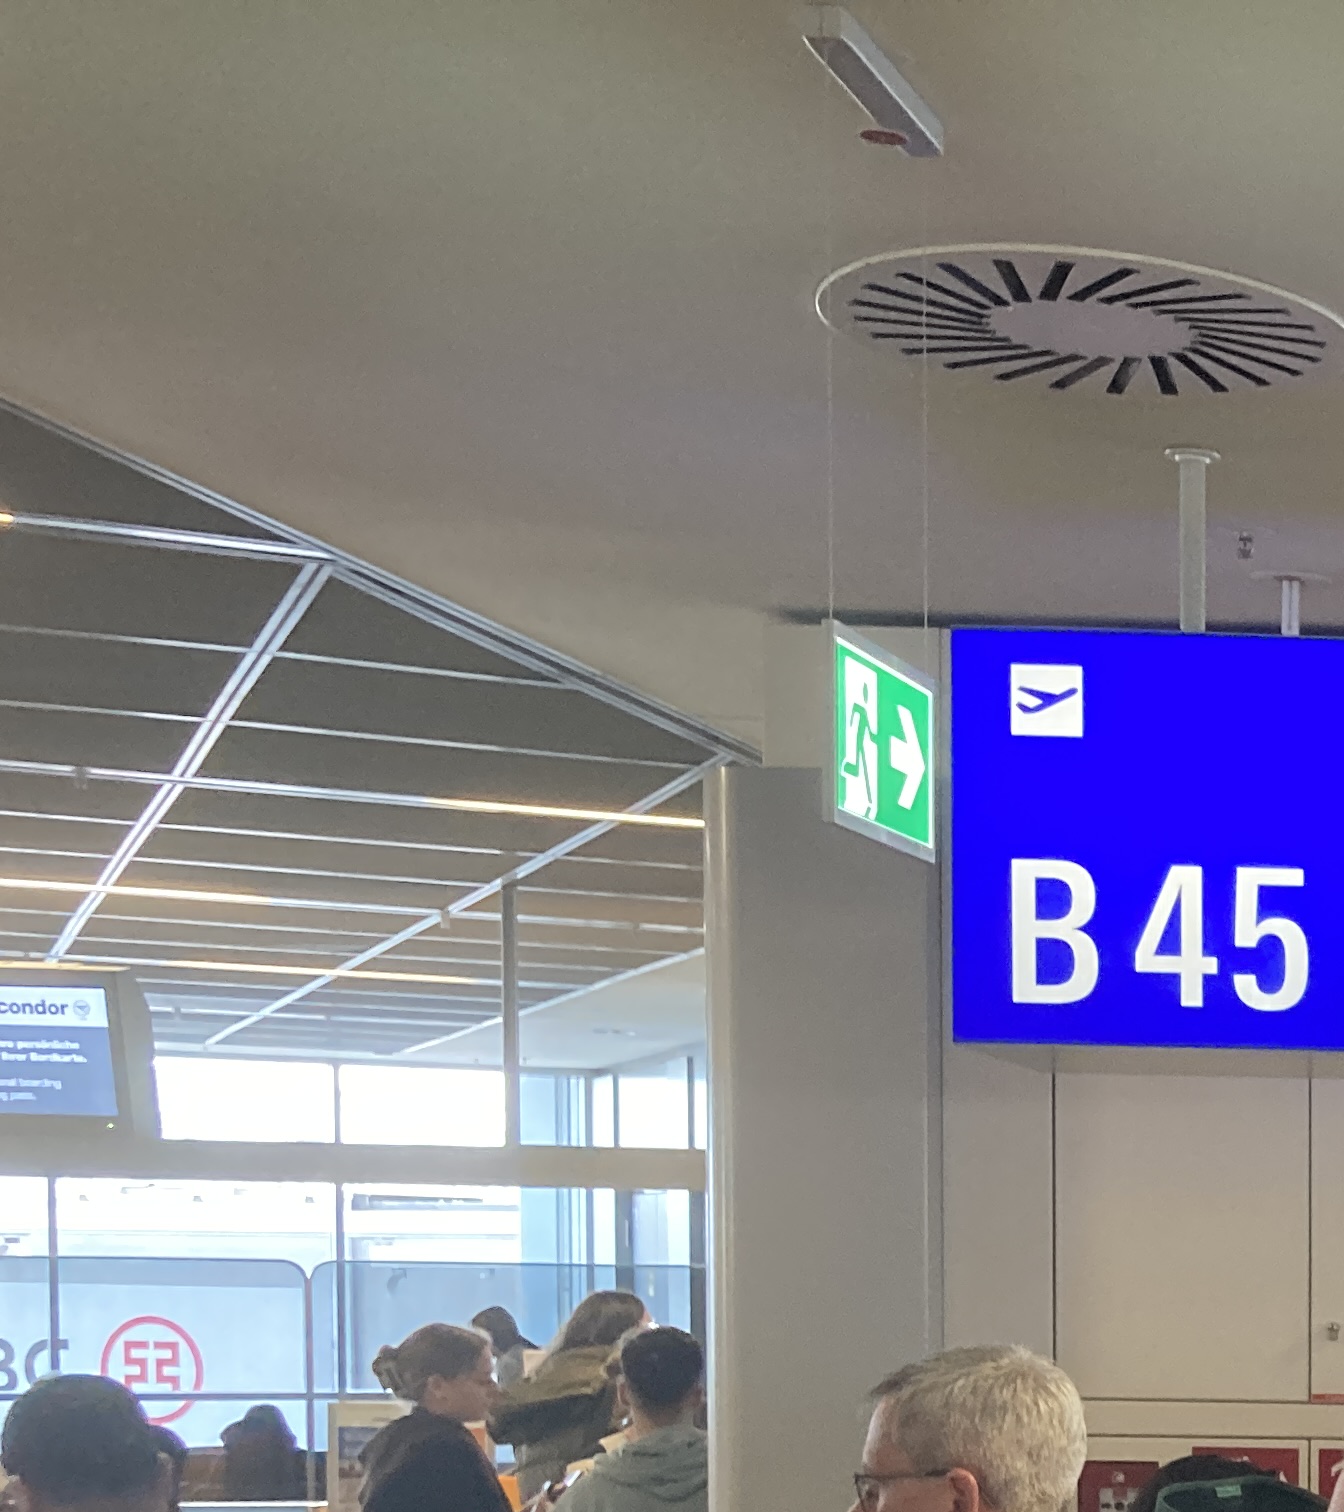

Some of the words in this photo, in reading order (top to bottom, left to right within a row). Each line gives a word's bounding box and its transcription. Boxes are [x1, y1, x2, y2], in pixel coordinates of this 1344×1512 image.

[1010, 858, 1099, 1004] B
[1134, 864, 1309, 1012] 45
[0, 999, 69, 1015] condor
